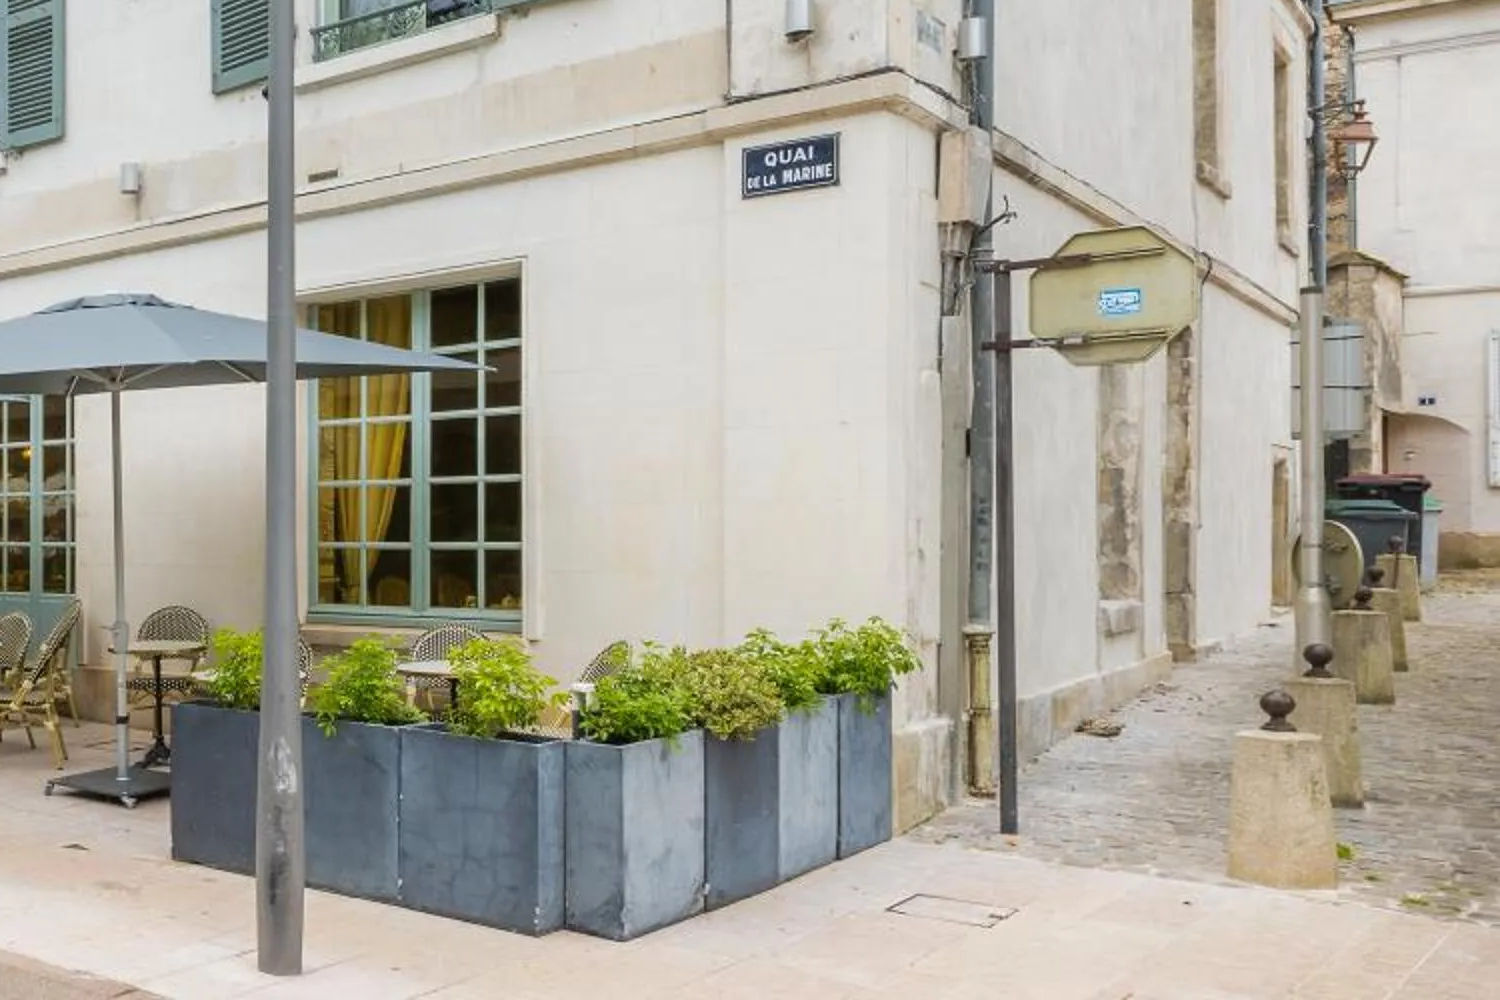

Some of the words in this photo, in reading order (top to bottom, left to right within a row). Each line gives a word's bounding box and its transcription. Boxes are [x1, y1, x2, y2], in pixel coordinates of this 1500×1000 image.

[764, 145, 815, 167] QUAI
[747, 175, 761, 189] DE
[763, 173, 777, 187] LA
[782, 163, 833, 184] MARINE
